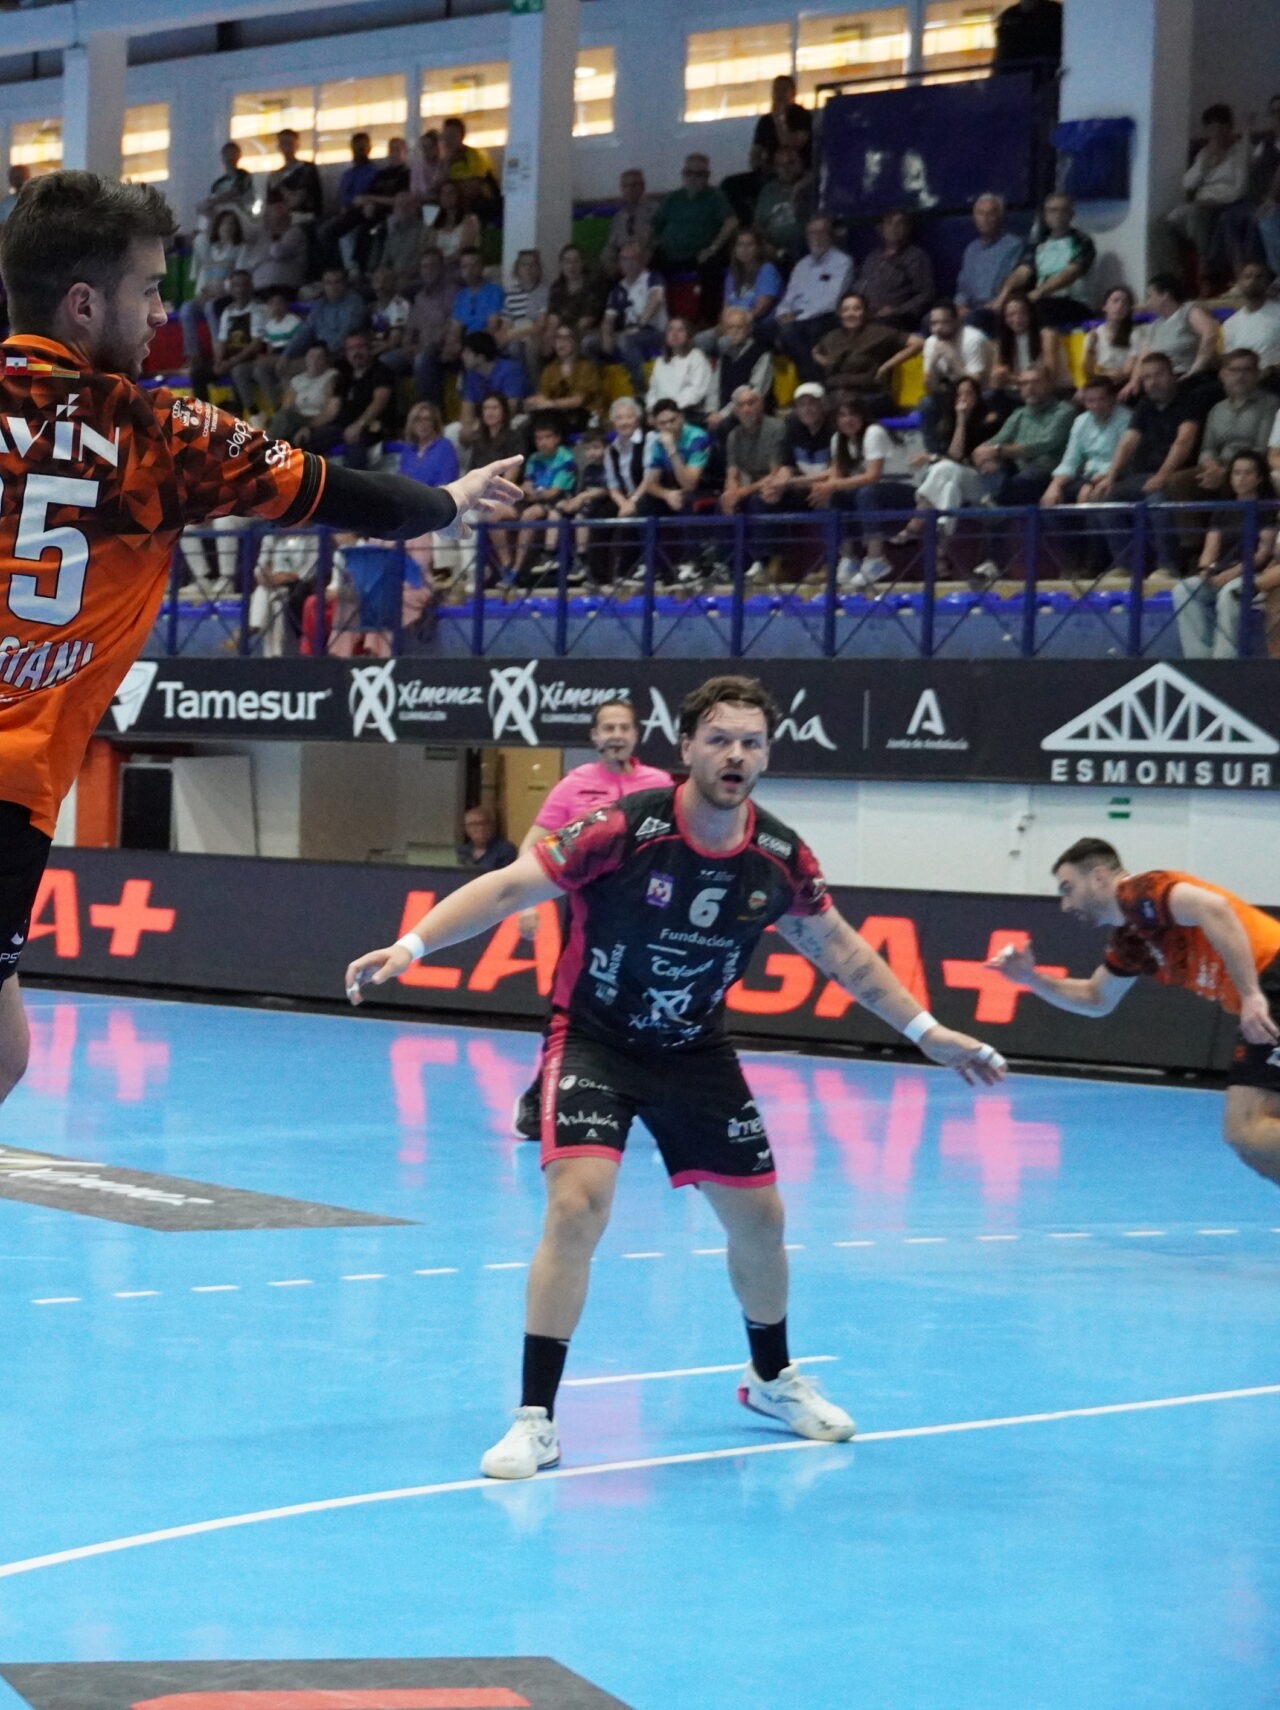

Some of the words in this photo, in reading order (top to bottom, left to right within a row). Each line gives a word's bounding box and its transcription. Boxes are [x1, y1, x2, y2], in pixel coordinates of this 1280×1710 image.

[156, 681, 332, 720] Tamesur
[398, 680, 484, 709] Ximenez
[540, 681, 631, 710] Ximenez
[1050, 758, 1271, 787] ESMONSUR
[689, 887, 726, 928] 6
[659, 928, 736, 948] Fundación
